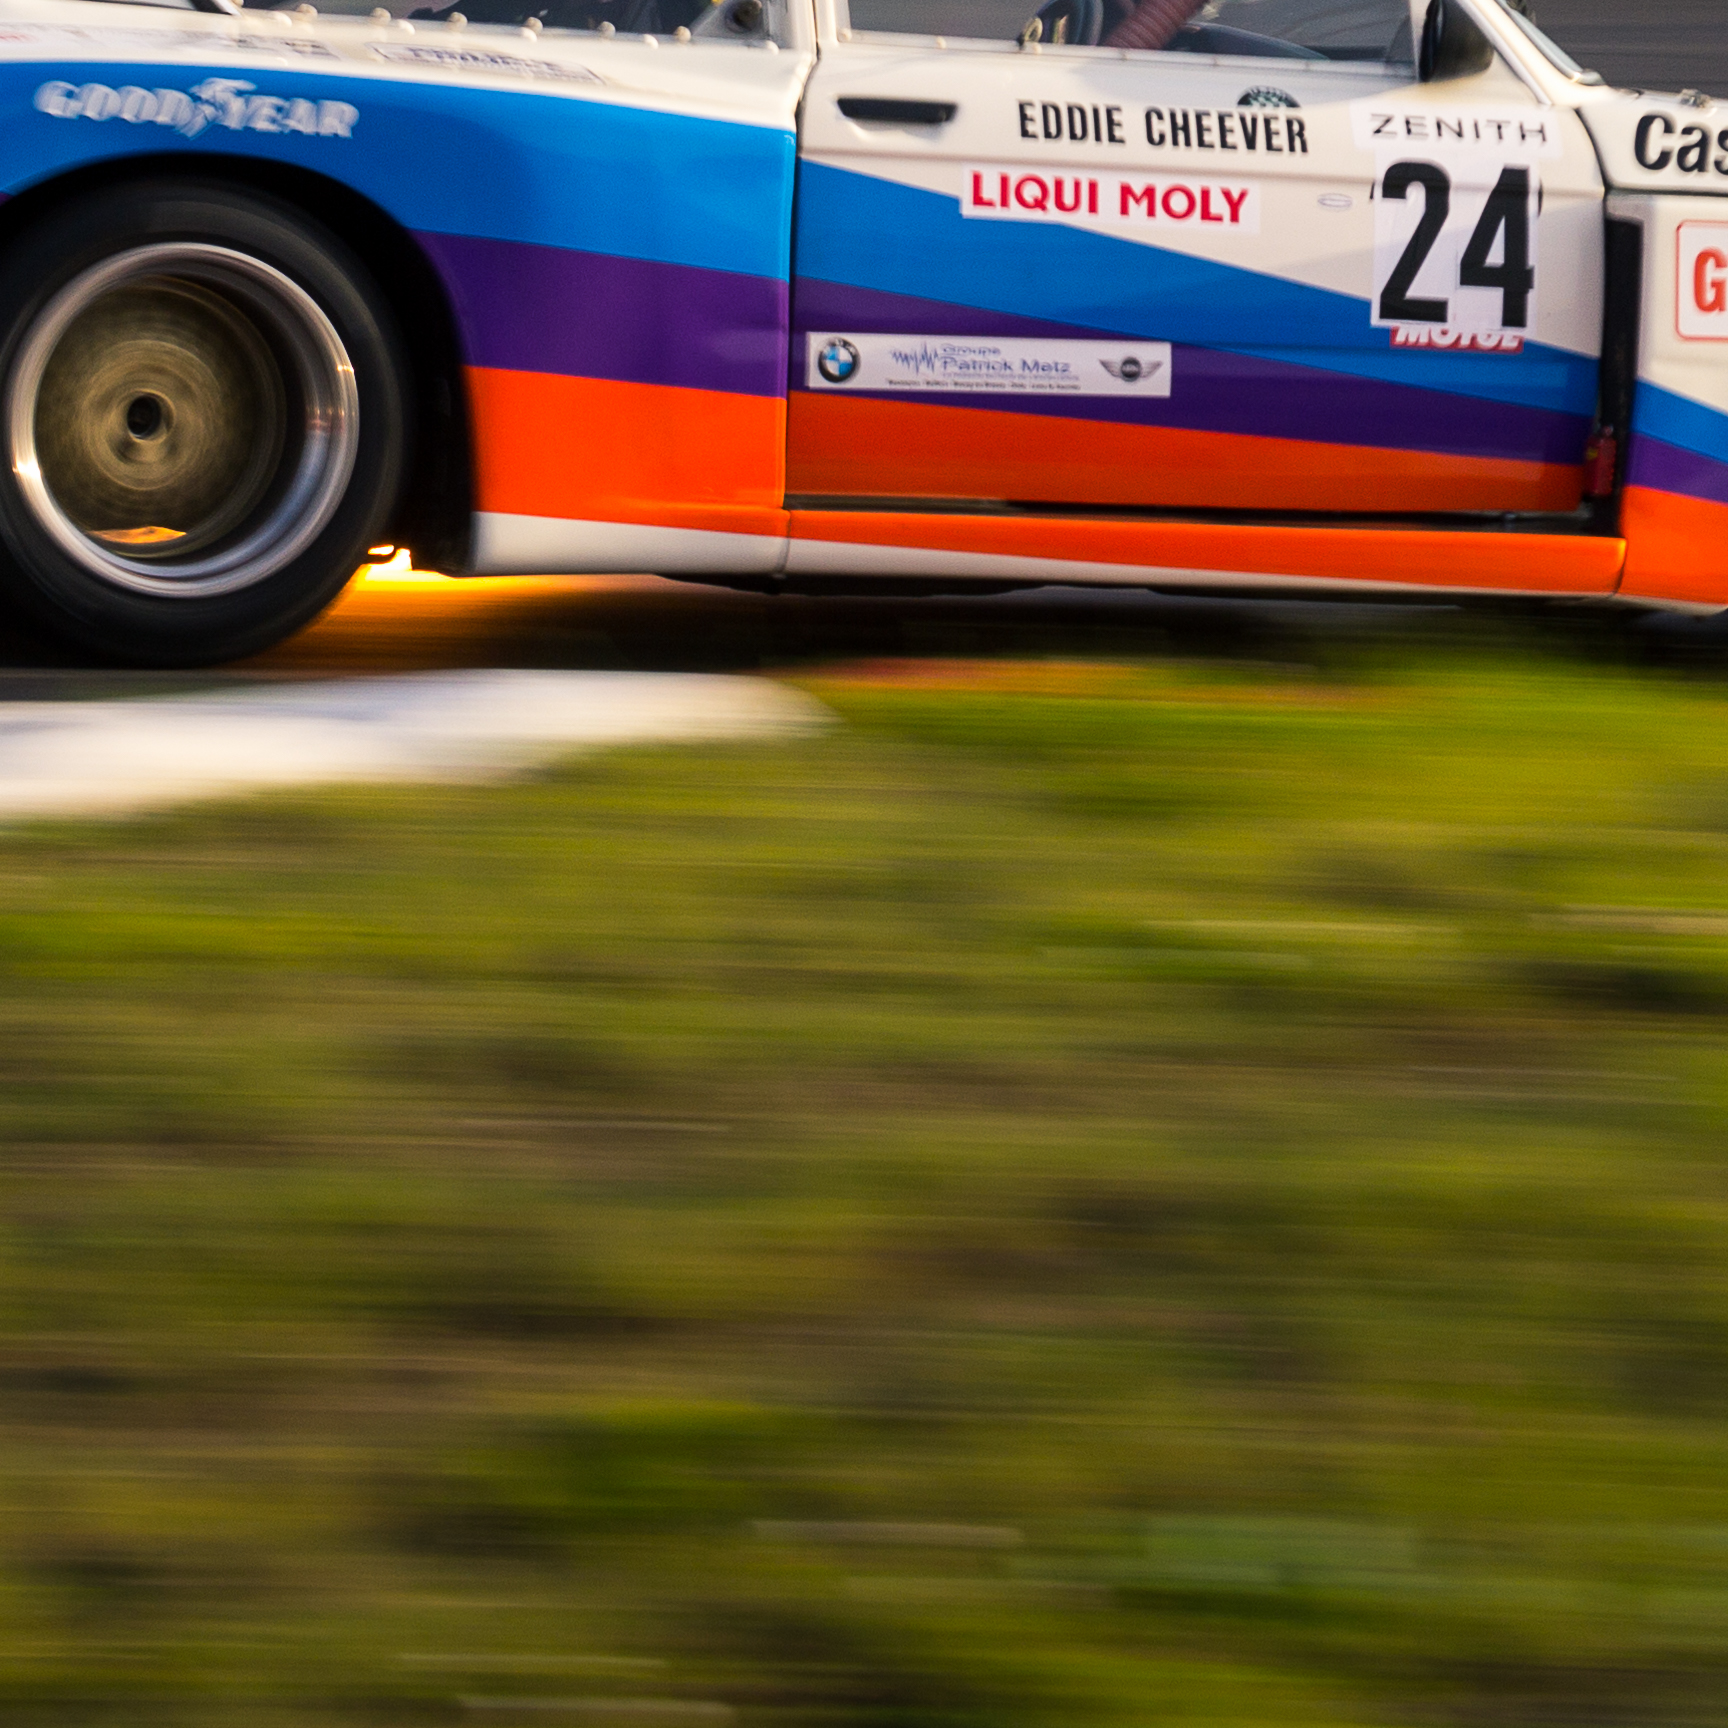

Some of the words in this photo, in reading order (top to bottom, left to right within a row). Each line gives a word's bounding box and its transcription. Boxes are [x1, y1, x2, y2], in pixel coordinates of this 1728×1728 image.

[1017, 99, 1126, 144] EDDIE
[1144, 106, 1309, 154] CHEEVER
[1370, 112, 1548, 143] ZENITH
[971, 170, 1099, 213] LIQUI
[1119, 181, 1249, 224] MOLY
[1379, 157, 1536, 329] 24
[941, 356, 1014, 373] Patrick
